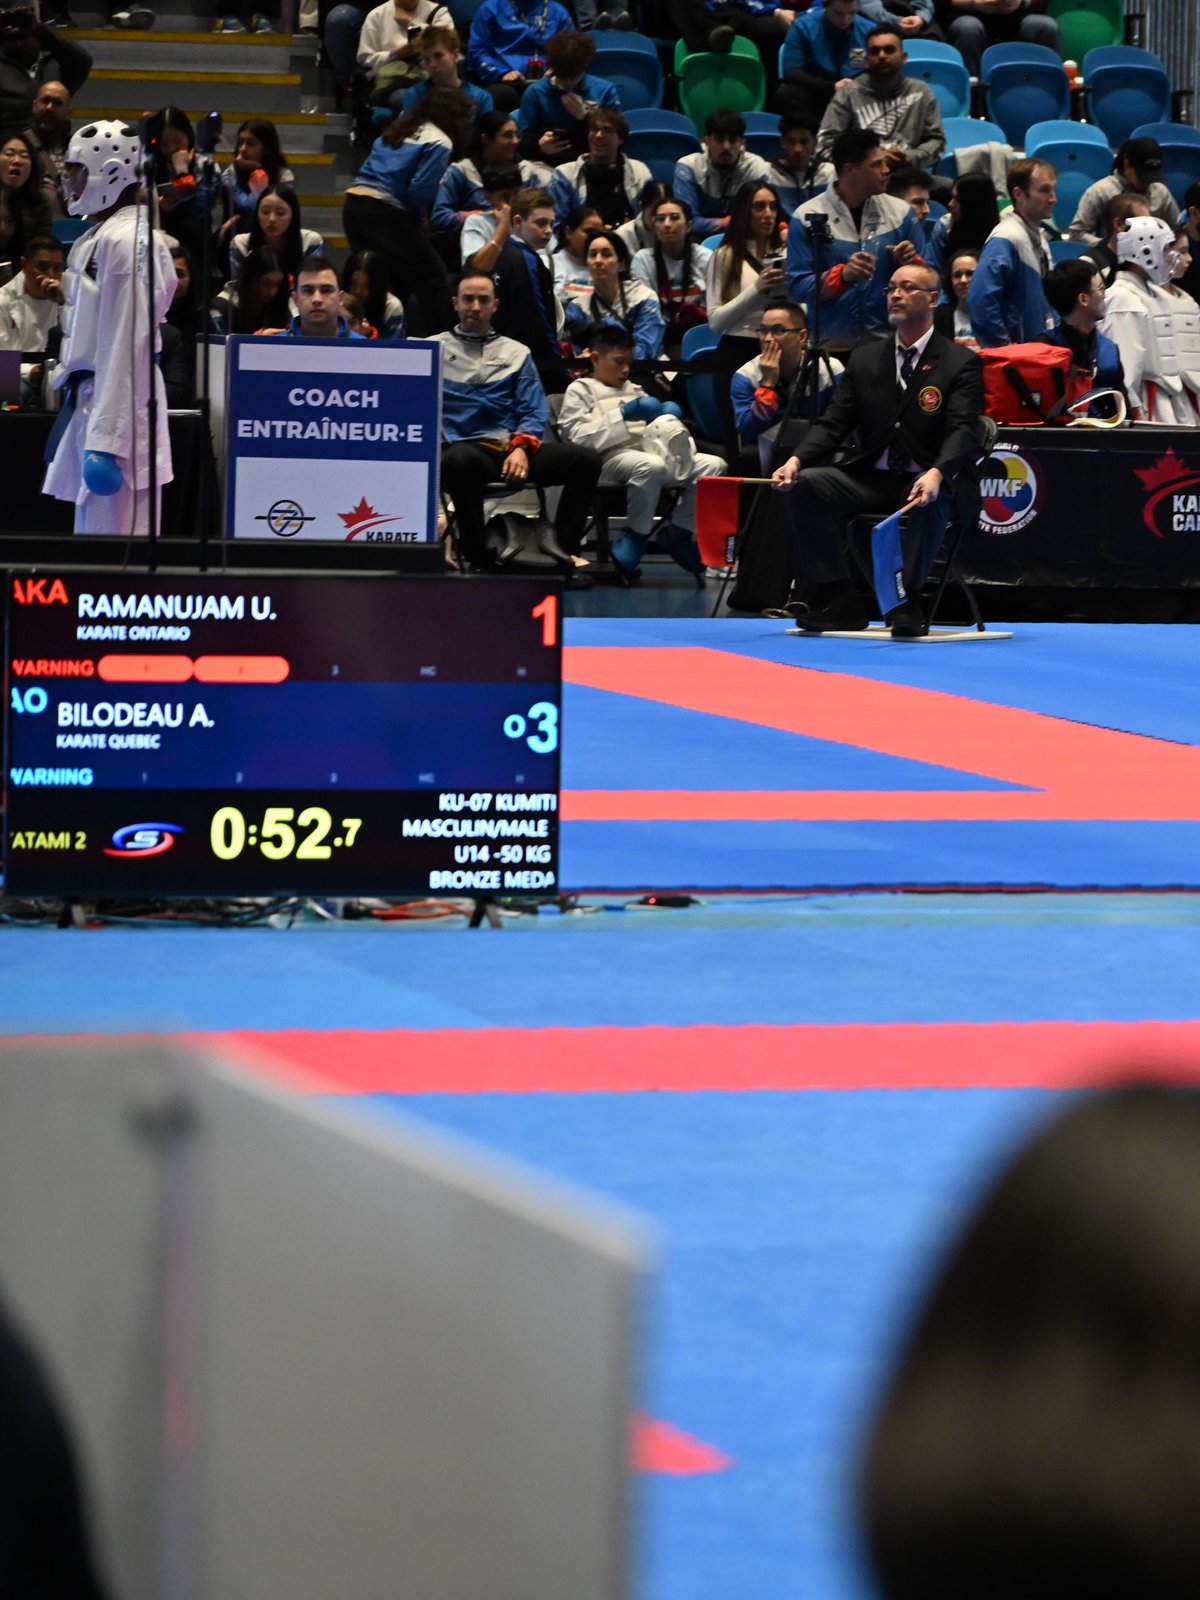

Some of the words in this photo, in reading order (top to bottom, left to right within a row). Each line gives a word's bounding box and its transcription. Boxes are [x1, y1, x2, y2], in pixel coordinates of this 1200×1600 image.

[288, 387, 379, 409] COACH
[980, 478, 1022, 498] WKF
[77, 593, 245, 620] RAMANUJAM
[251, 595, 278, 621] U.
[531, 594, 557, 647] 1
[76, 625, 128, 641] KARATE
[128, 625, 191, 642] ONTARIO
[57, 702, 184, 728] BILODEAU
[188, 702, 216, 728] A.
[56, 734, 107, 749] KARATE
[107, 734, 162, 751] QUEBEC
[438, 793, 494, 812] KU-07
[210, 806, 363, 861] 0:52.7
[402, 819, 549, 840] MASCULIN/MALE
[10, 831, 71, 849] ATAMI
[75, 831, 87, 850] 2
[454, 845, 490, 863] U14
[493, 845, 524, 863] -50
[525, 845, 552, 863] KG
[429, 871, 502, 889] BRONZE
